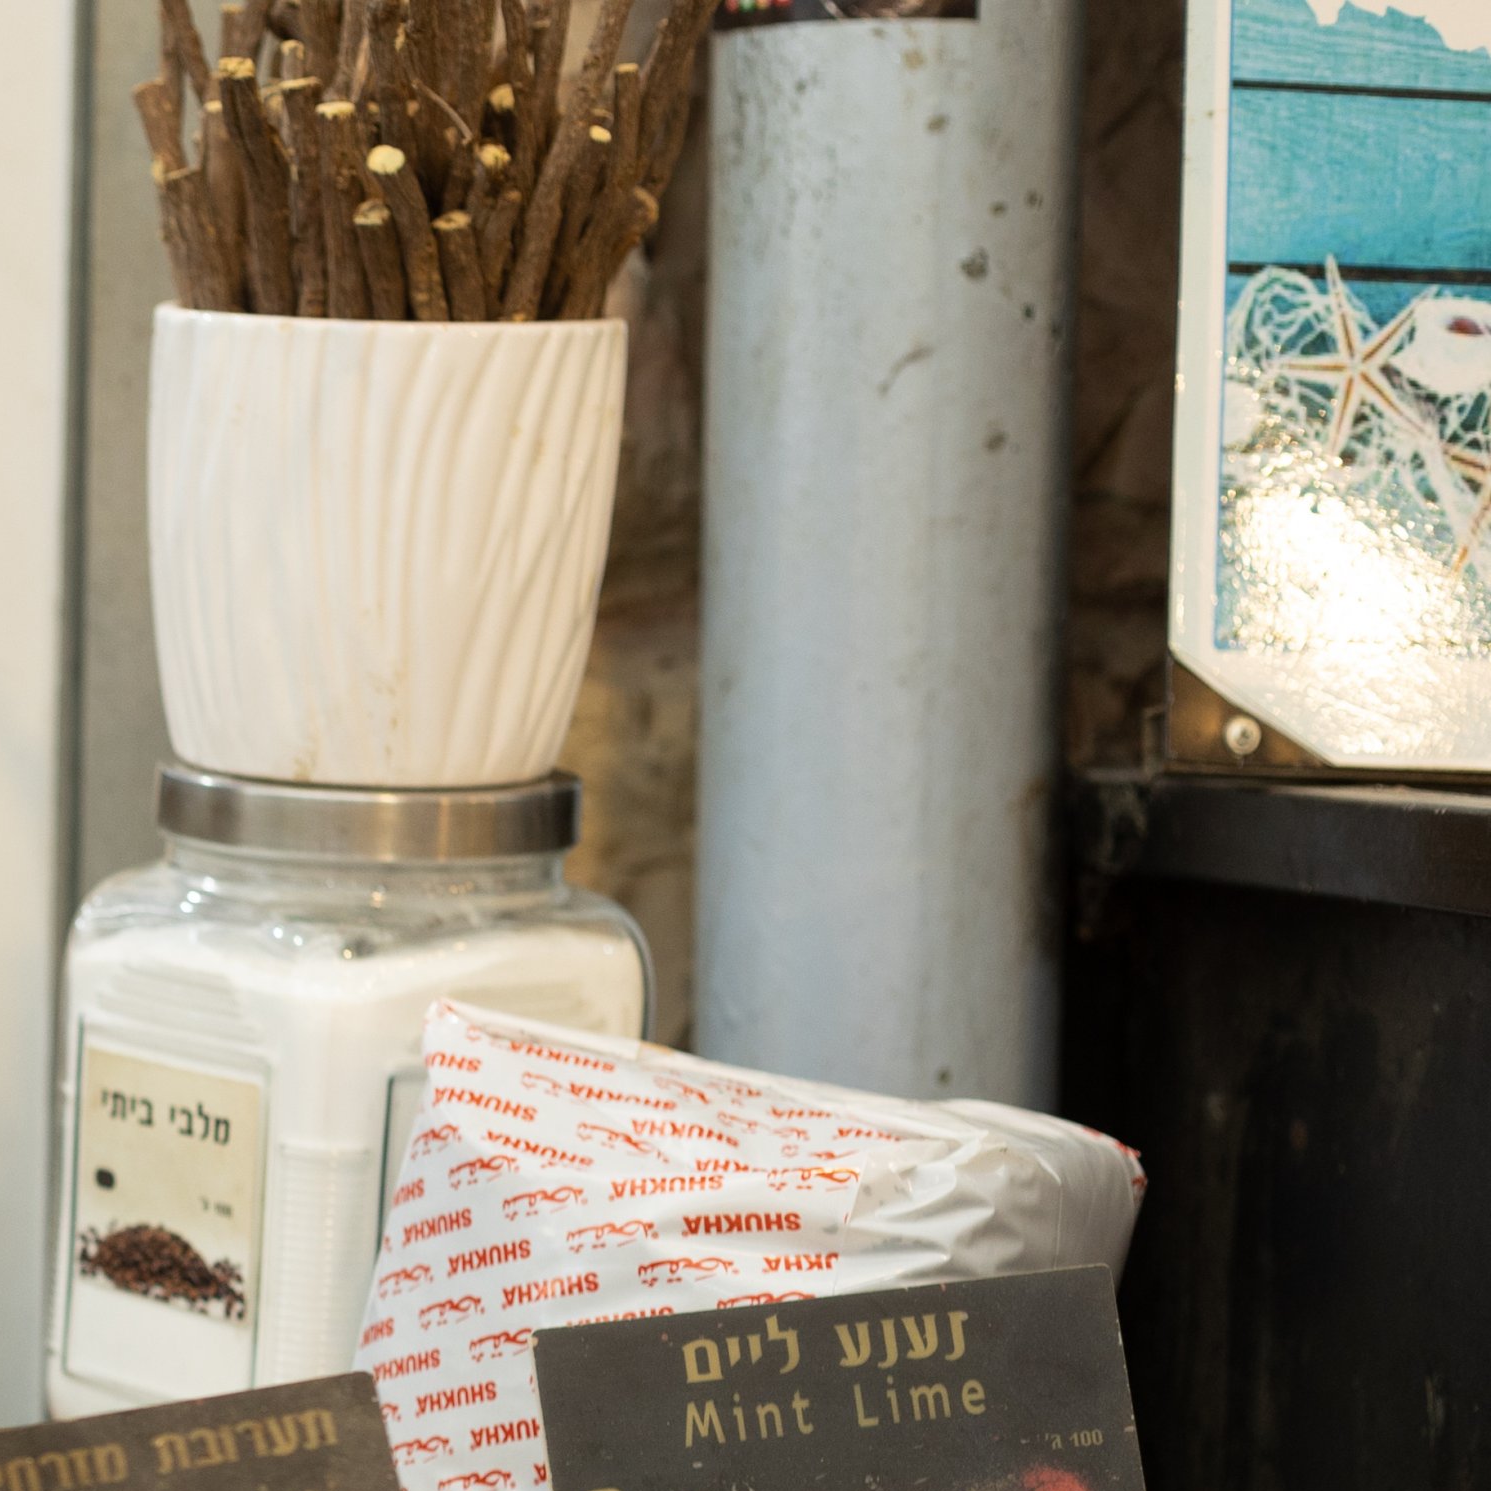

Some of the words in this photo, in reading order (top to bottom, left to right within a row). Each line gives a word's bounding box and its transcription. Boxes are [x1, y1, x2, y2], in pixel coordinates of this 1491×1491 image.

[100, 1087, 154, 1128] ביתי
[169, 1102, 231, 1146] מלבי
[432, 1086, 539, 1123] SHUKHA
[485, 1128, 594, 1169] SHUKHA
[632, 1119, 739, 1149] SHUKHA
[609, 1174, 725, 1201] SHUKHA
[403, 1207, 473, 1248] SHUKHA
[682, 1212, 802, 1237] SHUKHA
[447, 1239, 532, 1278] SHUKHA
[501, 1271, 601, 1310] SHUKHA
[680, 1313, 802, 1386] ליים
[833, 1309, 970, 1370] נענע
[373, 1349, 442, 1384] SHUKHA
[415, 1381, 498, 1418] SHUKHA
[683, 1389, 816, 1449] Mint
[853, 1374, 988, 1430] Lime
[150, 1408, 339, 1475] תערובת
[1068, 1426, 1104, 1449] 100
